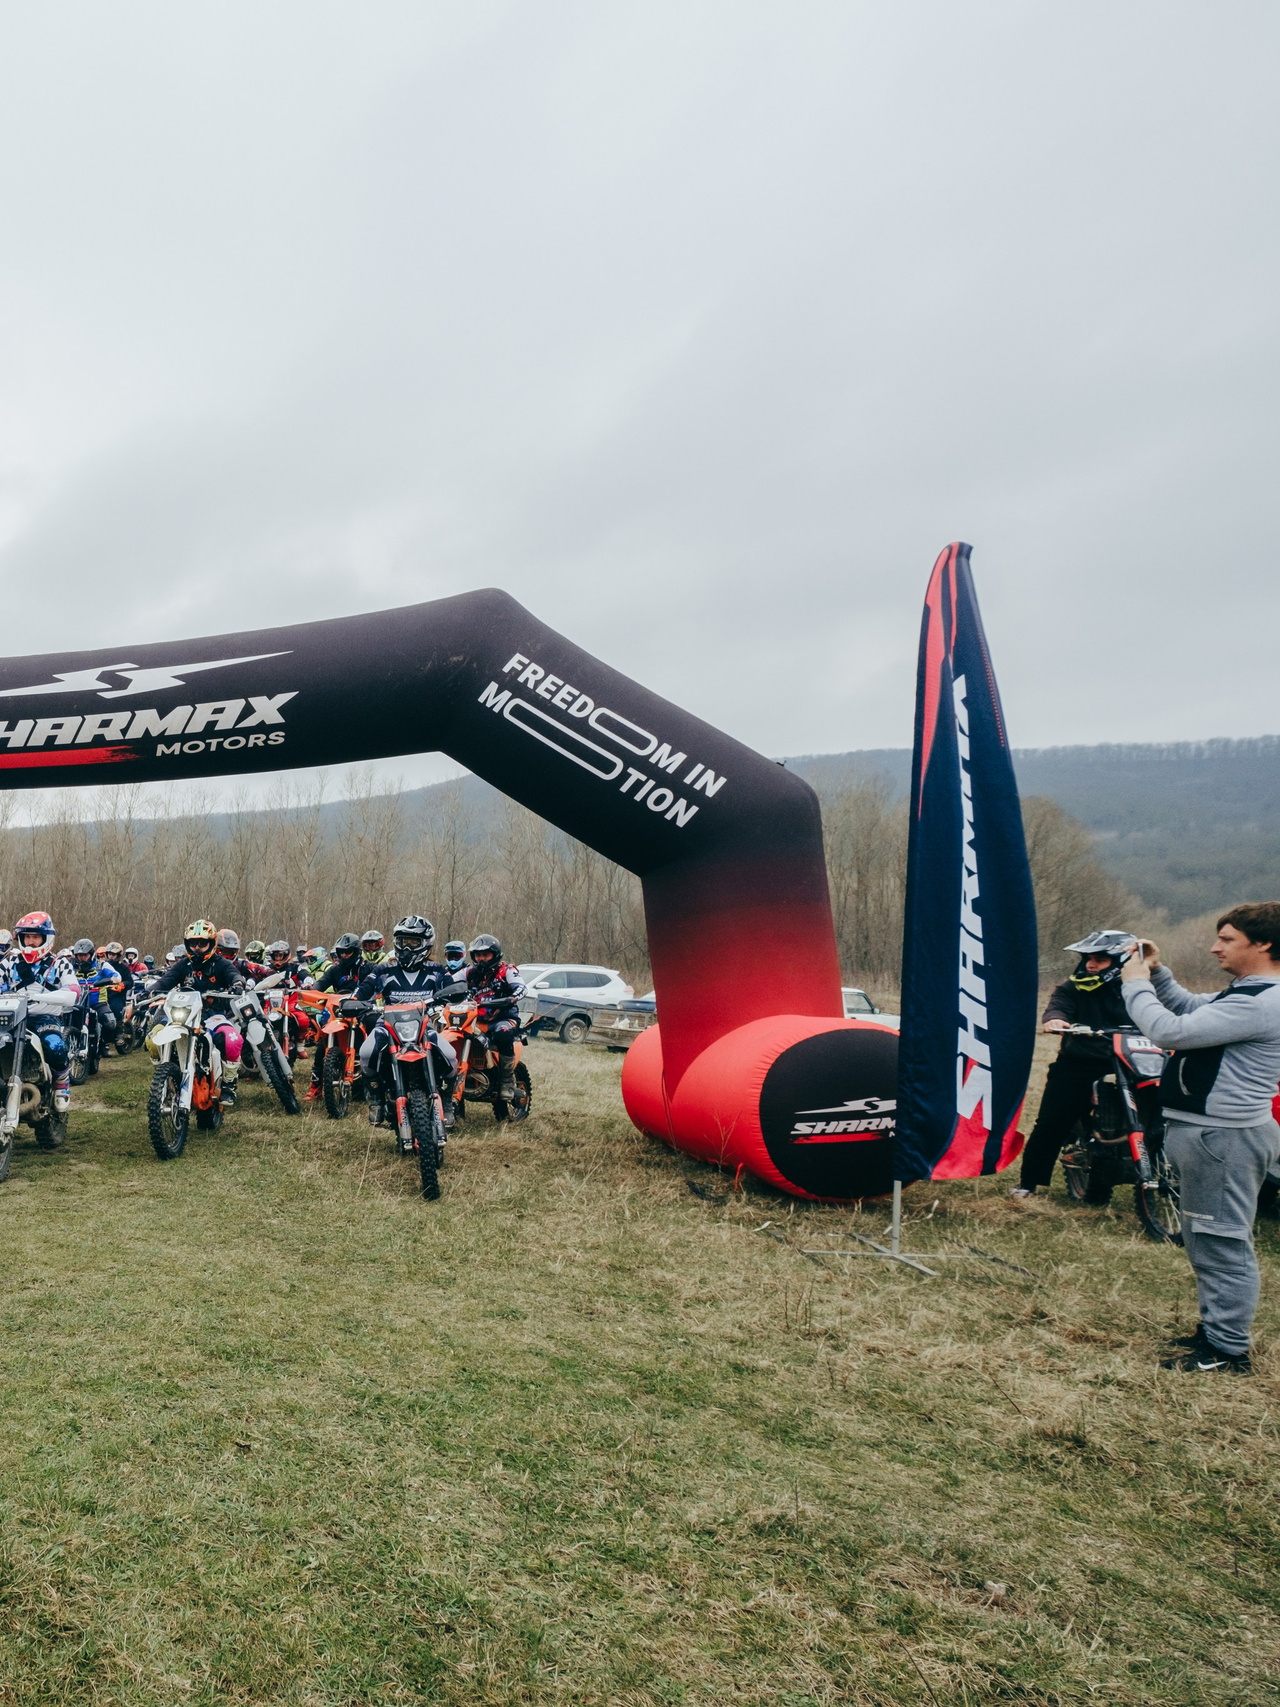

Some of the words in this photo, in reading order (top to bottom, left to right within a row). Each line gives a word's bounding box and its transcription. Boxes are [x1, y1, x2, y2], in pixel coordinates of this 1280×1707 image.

[156, 731, 286, 757] MOTORS
[477, 681, 700, 828] MOTION
[502, 652, 688, 775] FREEDOM
[683, 763, 728, 798] IN
